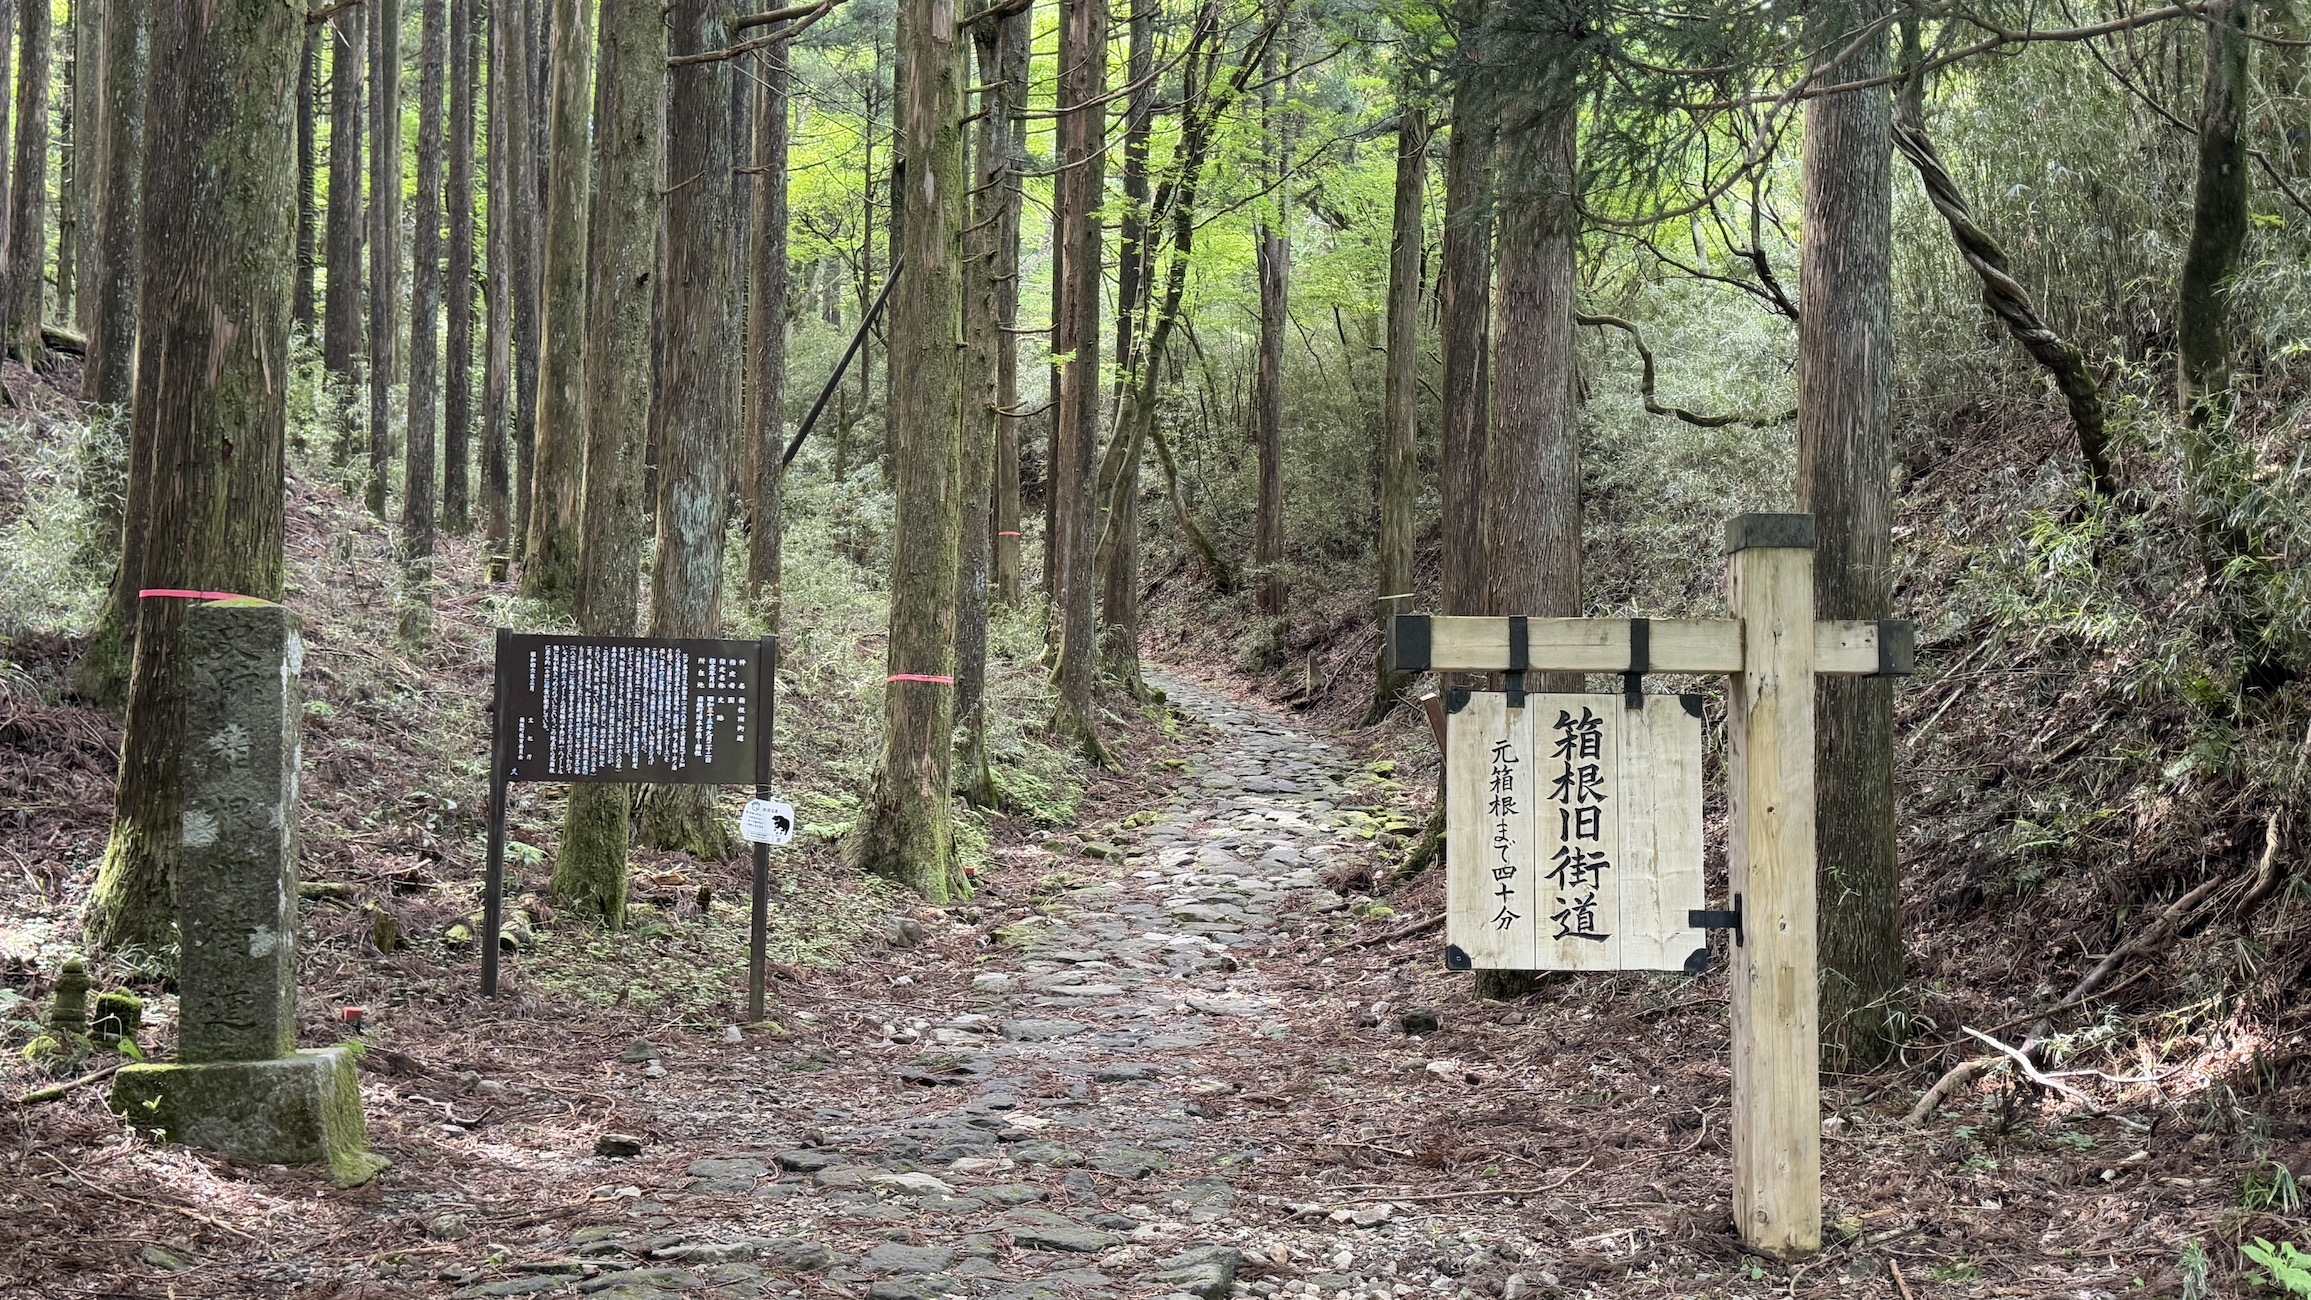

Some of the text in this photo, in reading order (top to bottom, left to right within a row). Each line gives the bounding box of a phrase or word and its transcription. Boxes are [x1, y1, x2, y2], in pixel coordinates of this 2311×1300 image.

[696, 657, 706, 689] 所在地
[736, 696, 746, 742] 箱根旧街道
[1487, 740, 1522, 932] 元箱根まで四十分
[1544, 706, 1612, 943] 箱根旧街道
